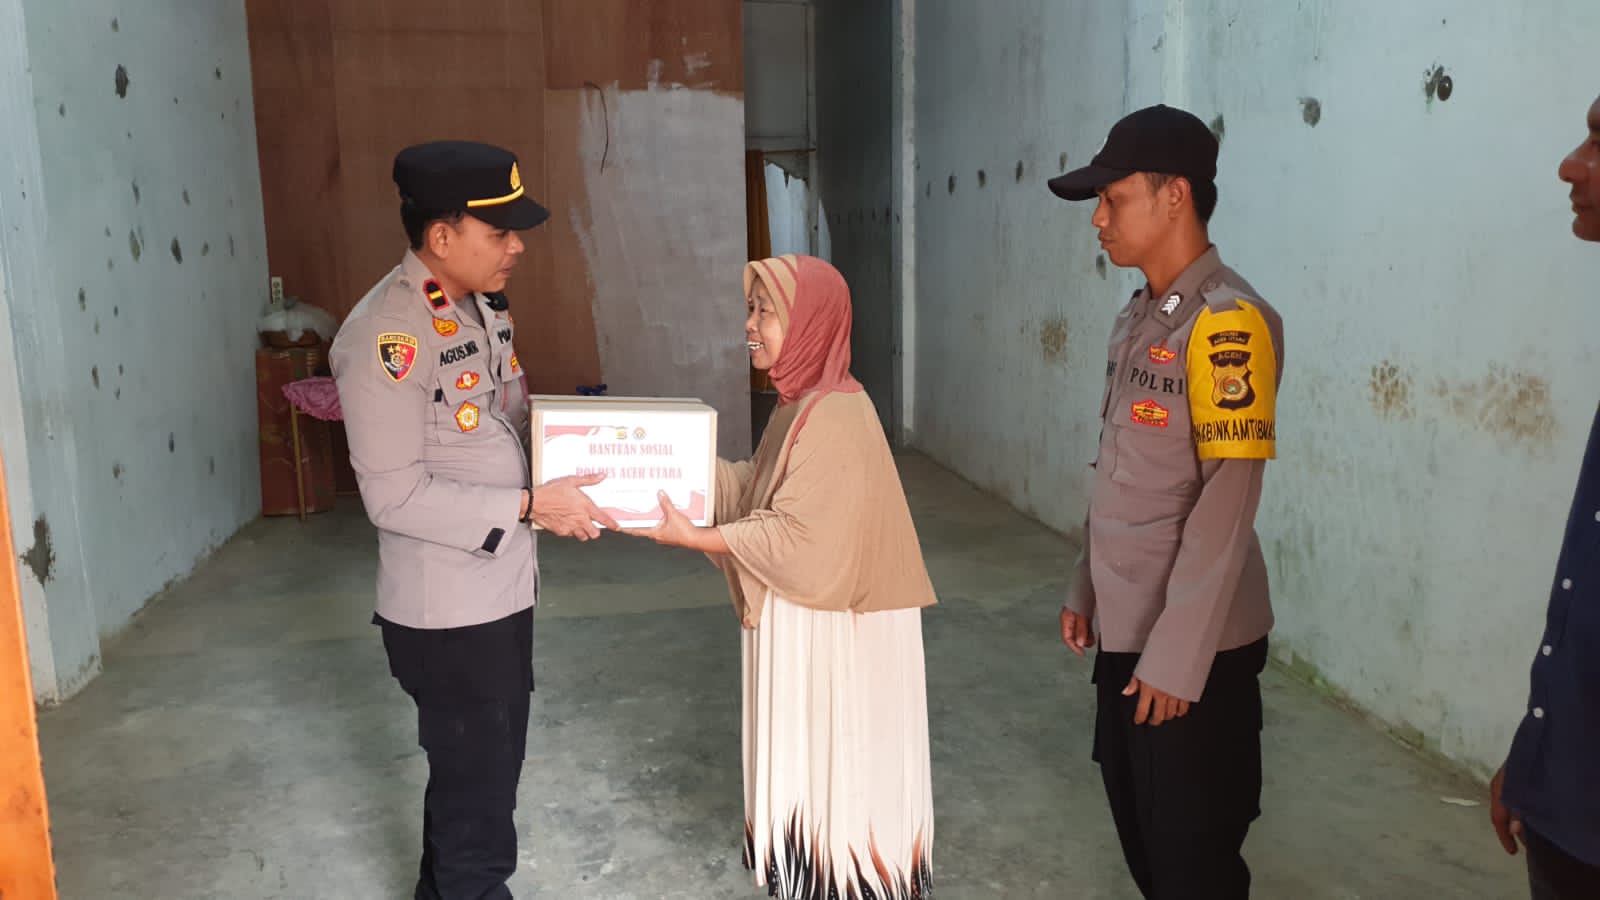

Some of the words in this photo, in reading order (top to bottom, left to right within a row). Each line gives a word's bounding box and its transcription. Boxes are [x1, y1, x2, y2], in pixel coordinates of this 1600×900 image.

[1218, 351, 1243, 361] ACEH
[1130, 367, 1184, 395] POLRI
[588, 442, 637, 456] BANTUAN
[639, 443, 674, 457] SOSIAL
[619, 466, 646, 480] ACEH
[649, 466, 683, 480] UTARA
